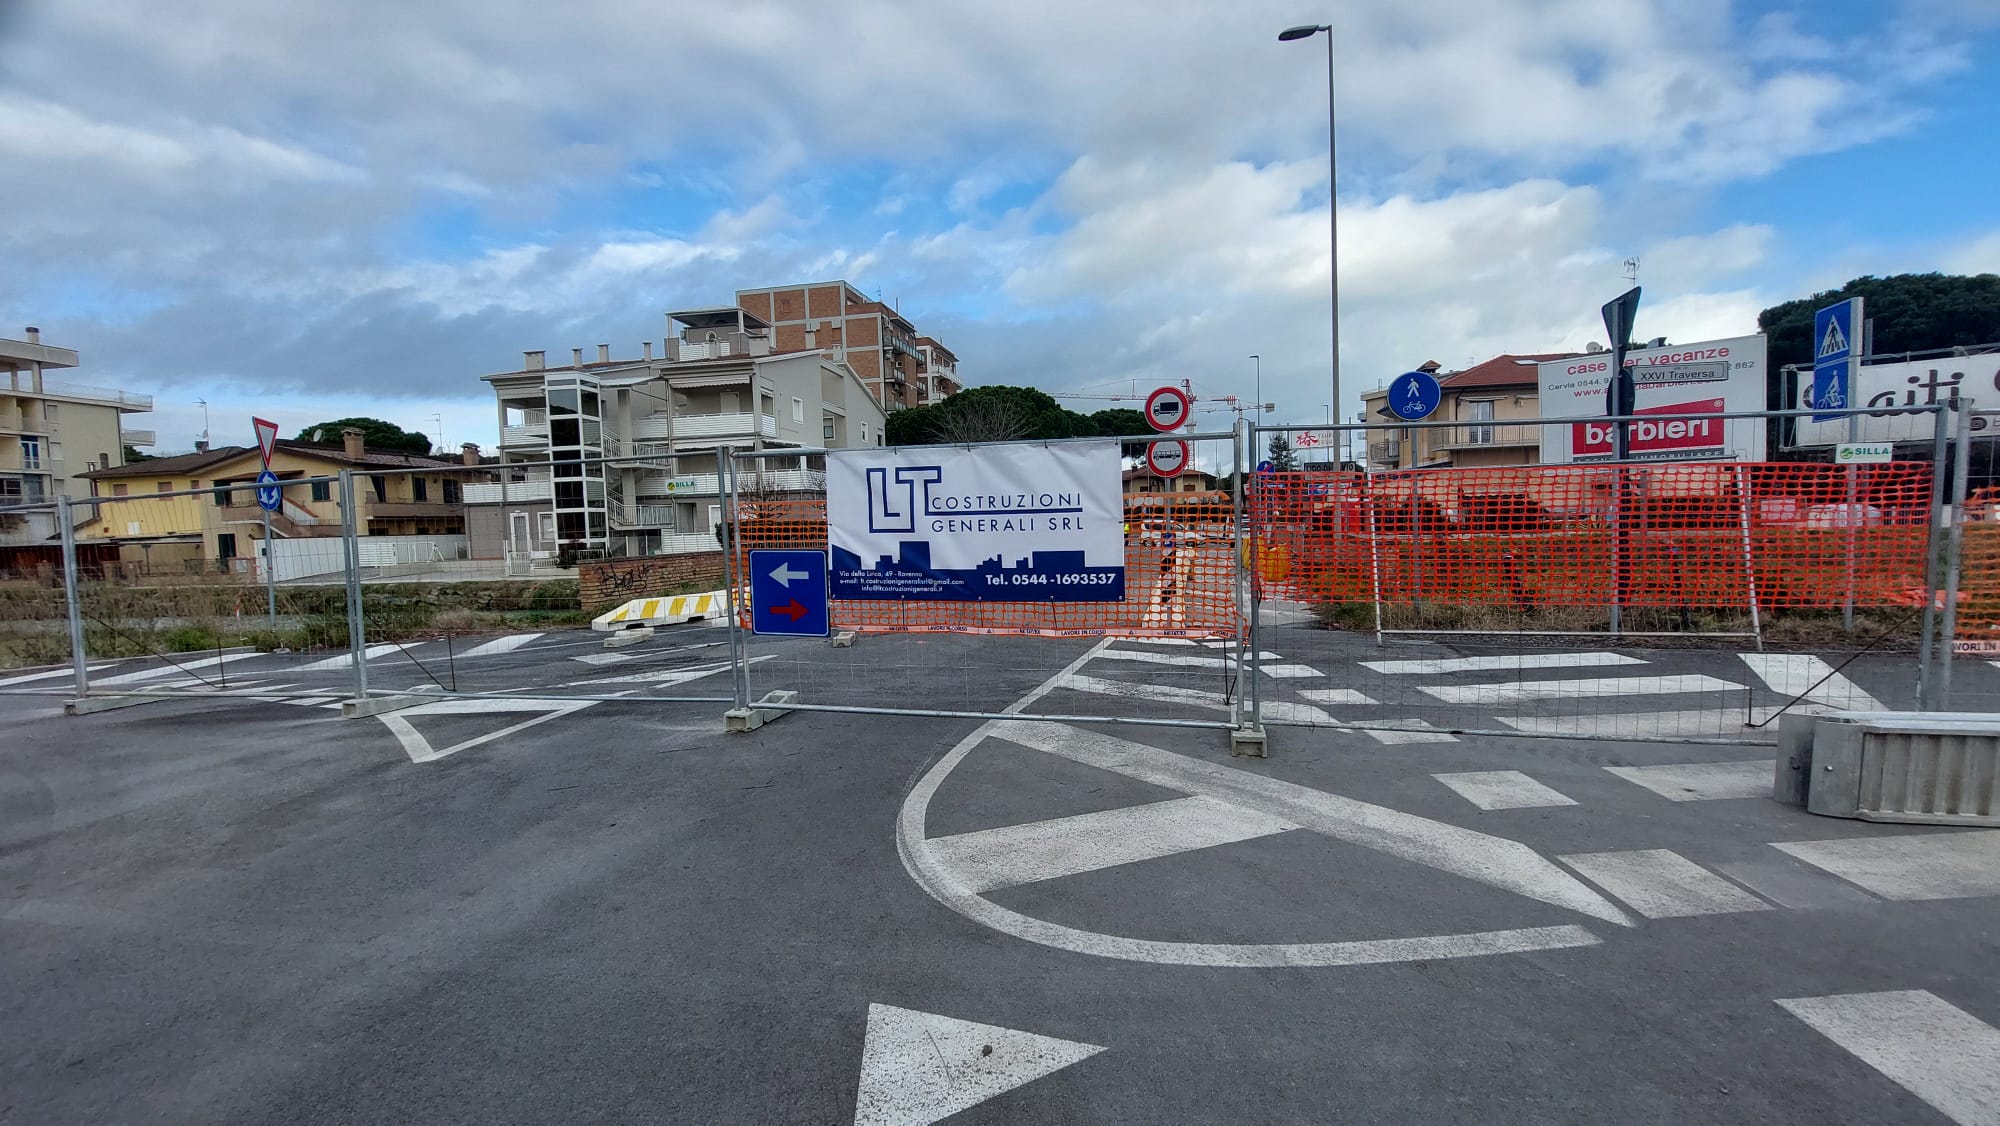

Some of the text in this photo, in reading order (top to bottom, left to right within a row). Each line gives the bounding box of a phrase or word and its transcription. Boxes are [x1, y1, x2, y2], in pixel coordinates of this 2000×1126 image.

[1567, 347, 1730, 375] case er vacanze
[1640, 370, 1715, 381] XXVI Traversa
[1548, 382, 1575, 391] Cervia
[1855, 447, 1889, 455] SILLA
[931, 493, 1082, 510] COSTRUZIONI
[931, 517, 1084, 533] GENERALI SRL
[985, 574, 1008, 585] Tel.
[1012, 574, 1048, 585] 0544
[1984, 642, 1996, 650] IN
